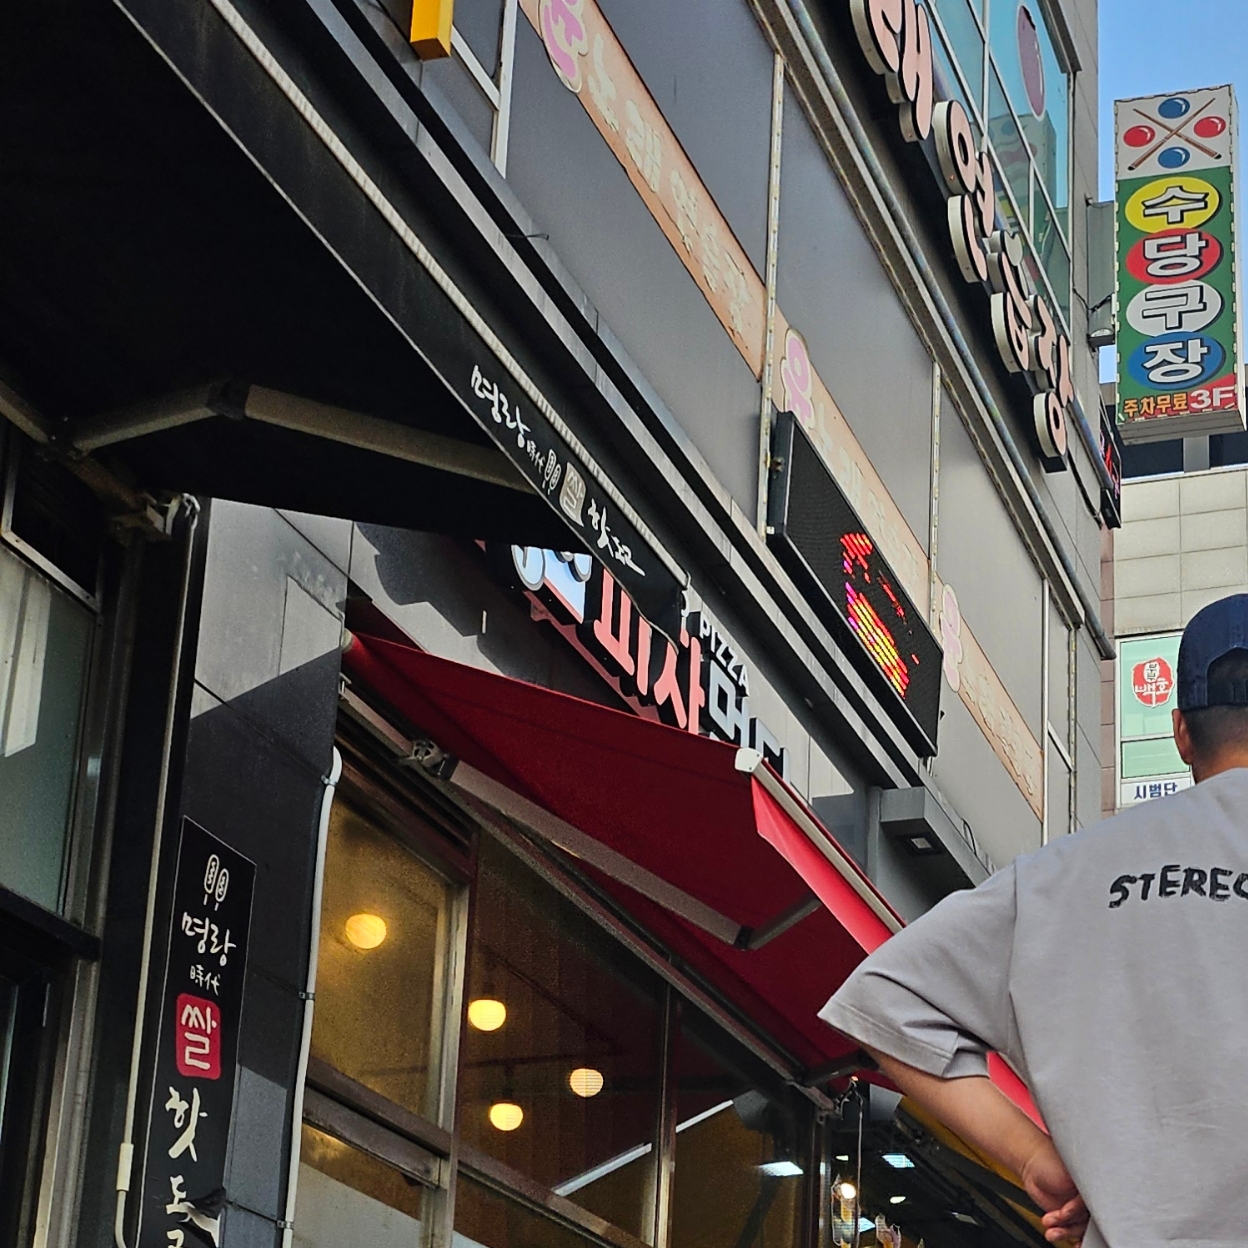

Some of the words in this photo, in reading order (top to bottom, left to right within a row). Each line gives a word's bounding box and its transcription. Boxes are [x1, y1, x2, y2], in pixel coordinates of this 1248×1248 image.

[1143, 185, 1210, 384] 수당구장
[1123, 391, 1189, 419] 주차무료
[1189, 385, 1236, 410] 3F
[700, 612, 751, 698] PIZZA
[181, 911, 237, 966] 명랑
[189, 964, 222, 996] 時代
[181, 1004, 217, 1071] 쌀
